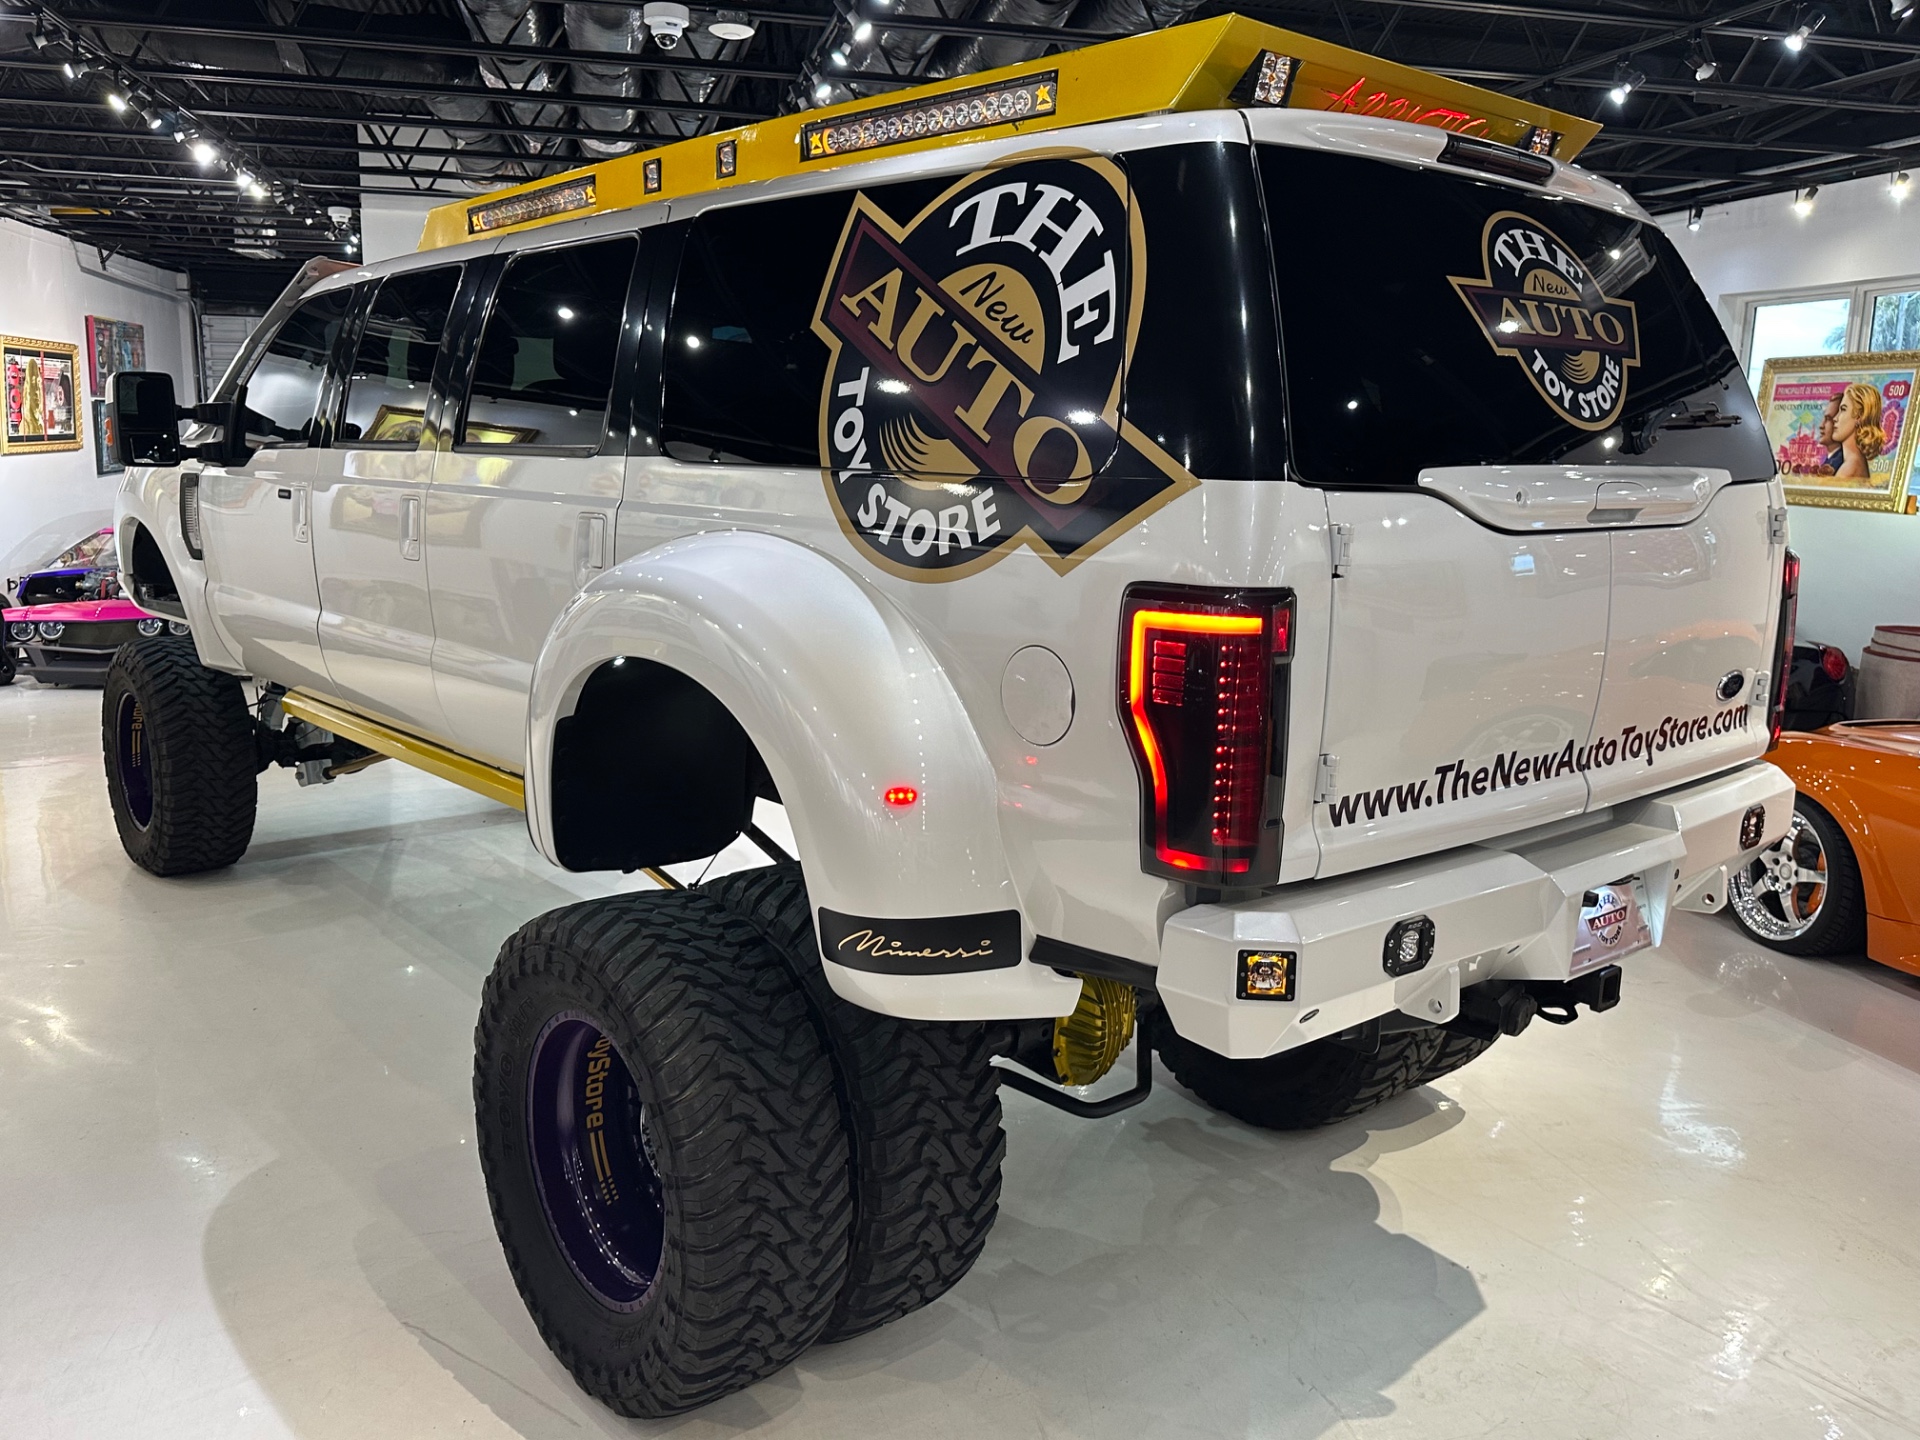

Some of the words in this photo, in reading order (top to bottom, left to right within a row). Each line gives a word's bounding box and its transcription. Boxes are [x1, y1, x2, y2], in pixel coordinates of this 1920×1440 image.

[949, 182, 1118, 364] THE
[1494, 229, 1583, 293] THE
[1533, 273, 1569, 295] New
[960, 271, 1035, 345] New
[1499, 297, 1625, 345] AUTO
[840, 267, 1093, 505] AUTO
[1532, 349, 1574, 410] TOY
[1578, 355, 1620, 419] STORE
[1888, 384, 1905, 397] 500
[833, 366, 872, 484] TOY
[857, 482, 1001, 558] STORE
[1871, 459, 1890, 472] 500
[1328, 703, 1749, 828] www.TheNewAutoToyStore.com
[1592, 909, 1625, 929] AUTO
